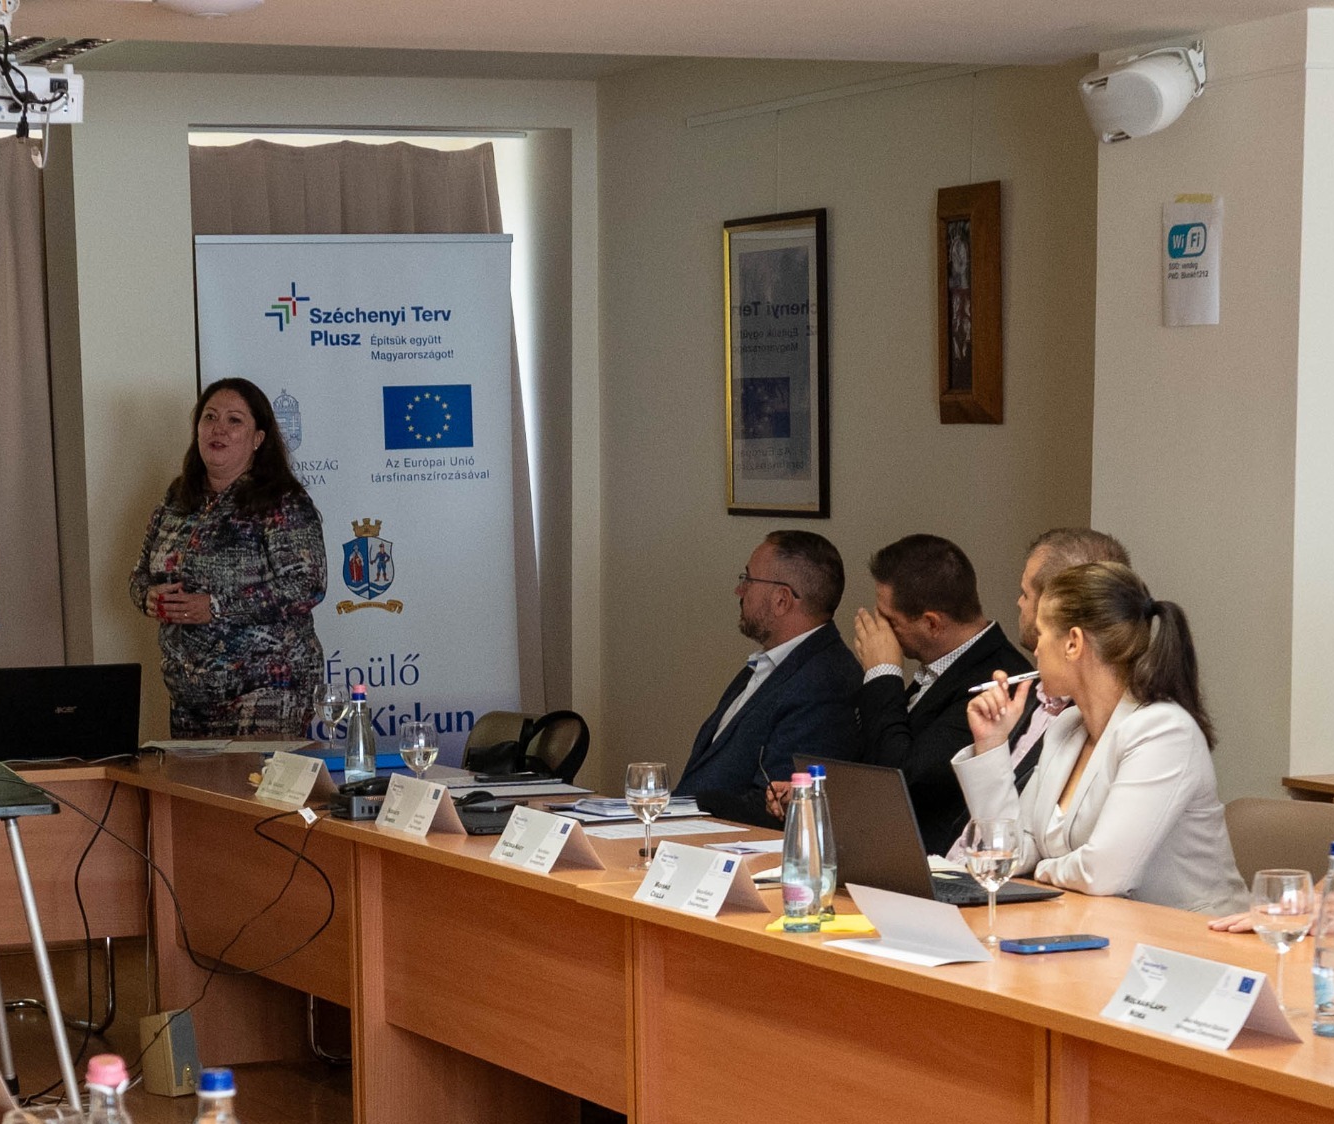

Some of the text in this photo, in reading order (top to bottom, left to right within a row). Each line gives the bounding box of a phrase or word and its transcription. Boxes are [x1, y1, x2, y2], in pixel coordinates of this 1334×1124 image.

[310, 306, 451, 326] Széchenyi Terv
[311, 330, 361, 346] Plusz
[371, 334, 441, 347] Építsük együtt
[371, 350, 453, 362] Magyarországot!
[291, 458, 339, 472] ORSZÁG
[386, 456, 474, 469] Az Európai Unió
[371, 469, 490, 483] társfinanszírozásával
[326, 650, 420, 692] Épülő
